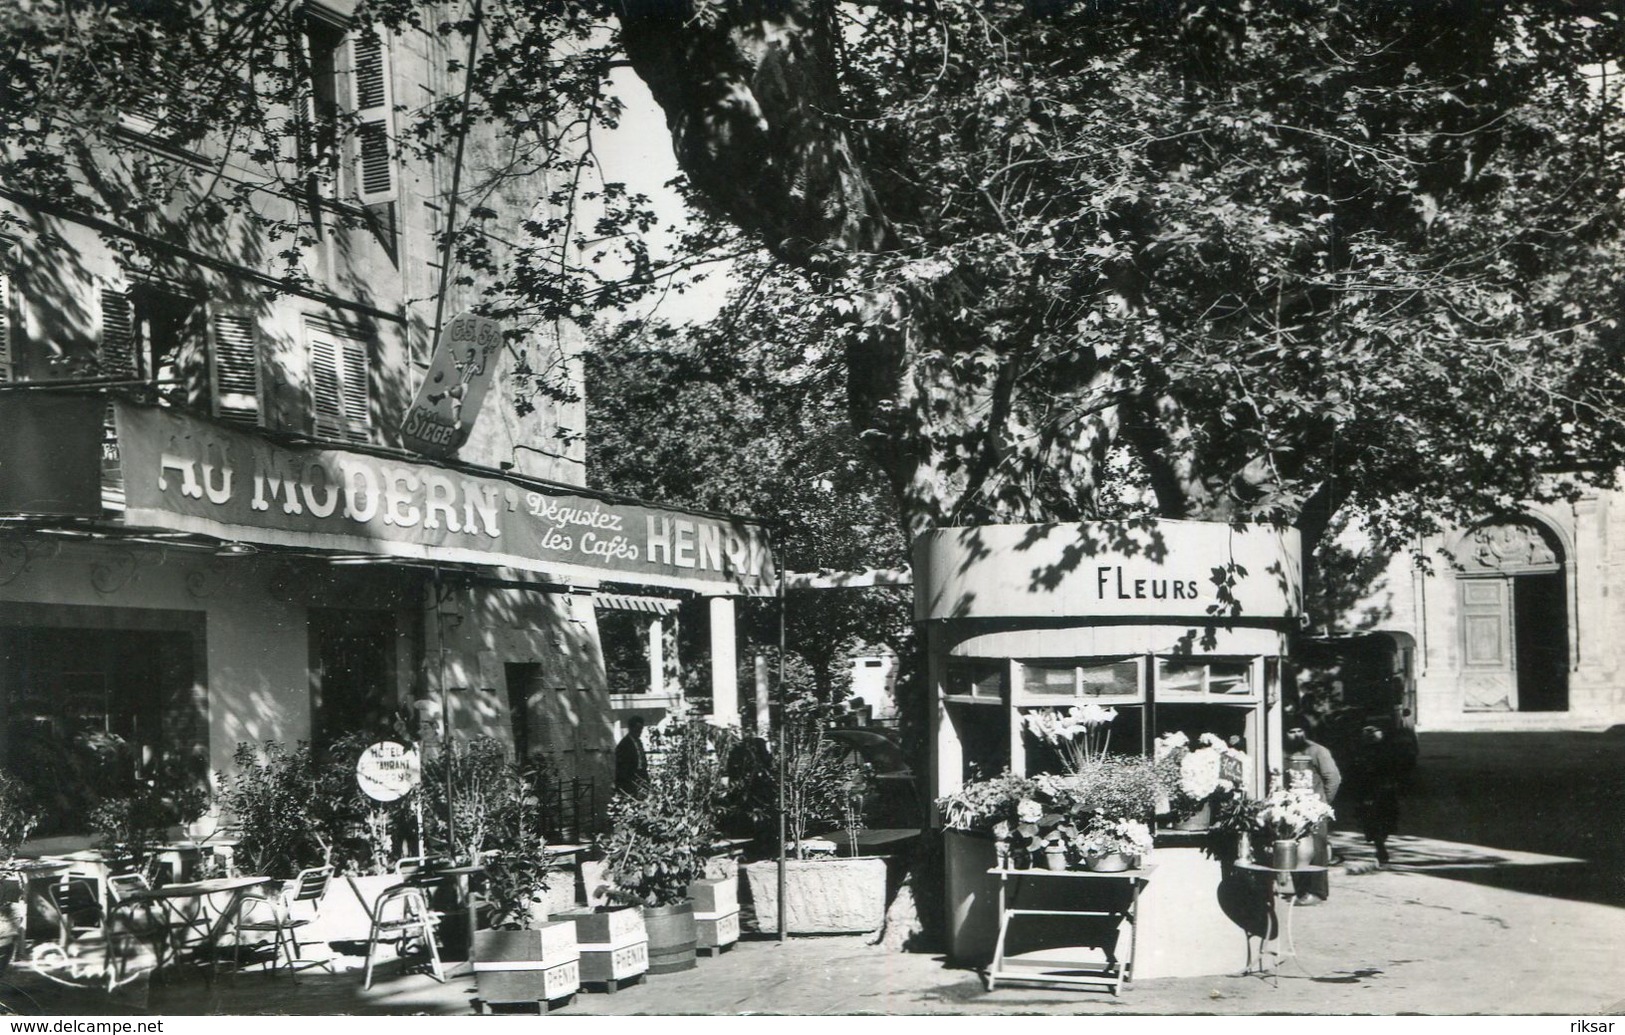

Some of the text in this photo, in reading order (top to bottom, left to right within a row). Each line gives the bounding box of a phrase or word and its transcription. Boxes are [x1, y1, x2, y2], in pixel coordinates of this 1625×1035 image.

[157, 436, 235, 505] AU
[526, 491, 623, 531] Dégustez
[541, 527, 639, 563] les Cafés
[646, 514, 760, 577] HENRI
